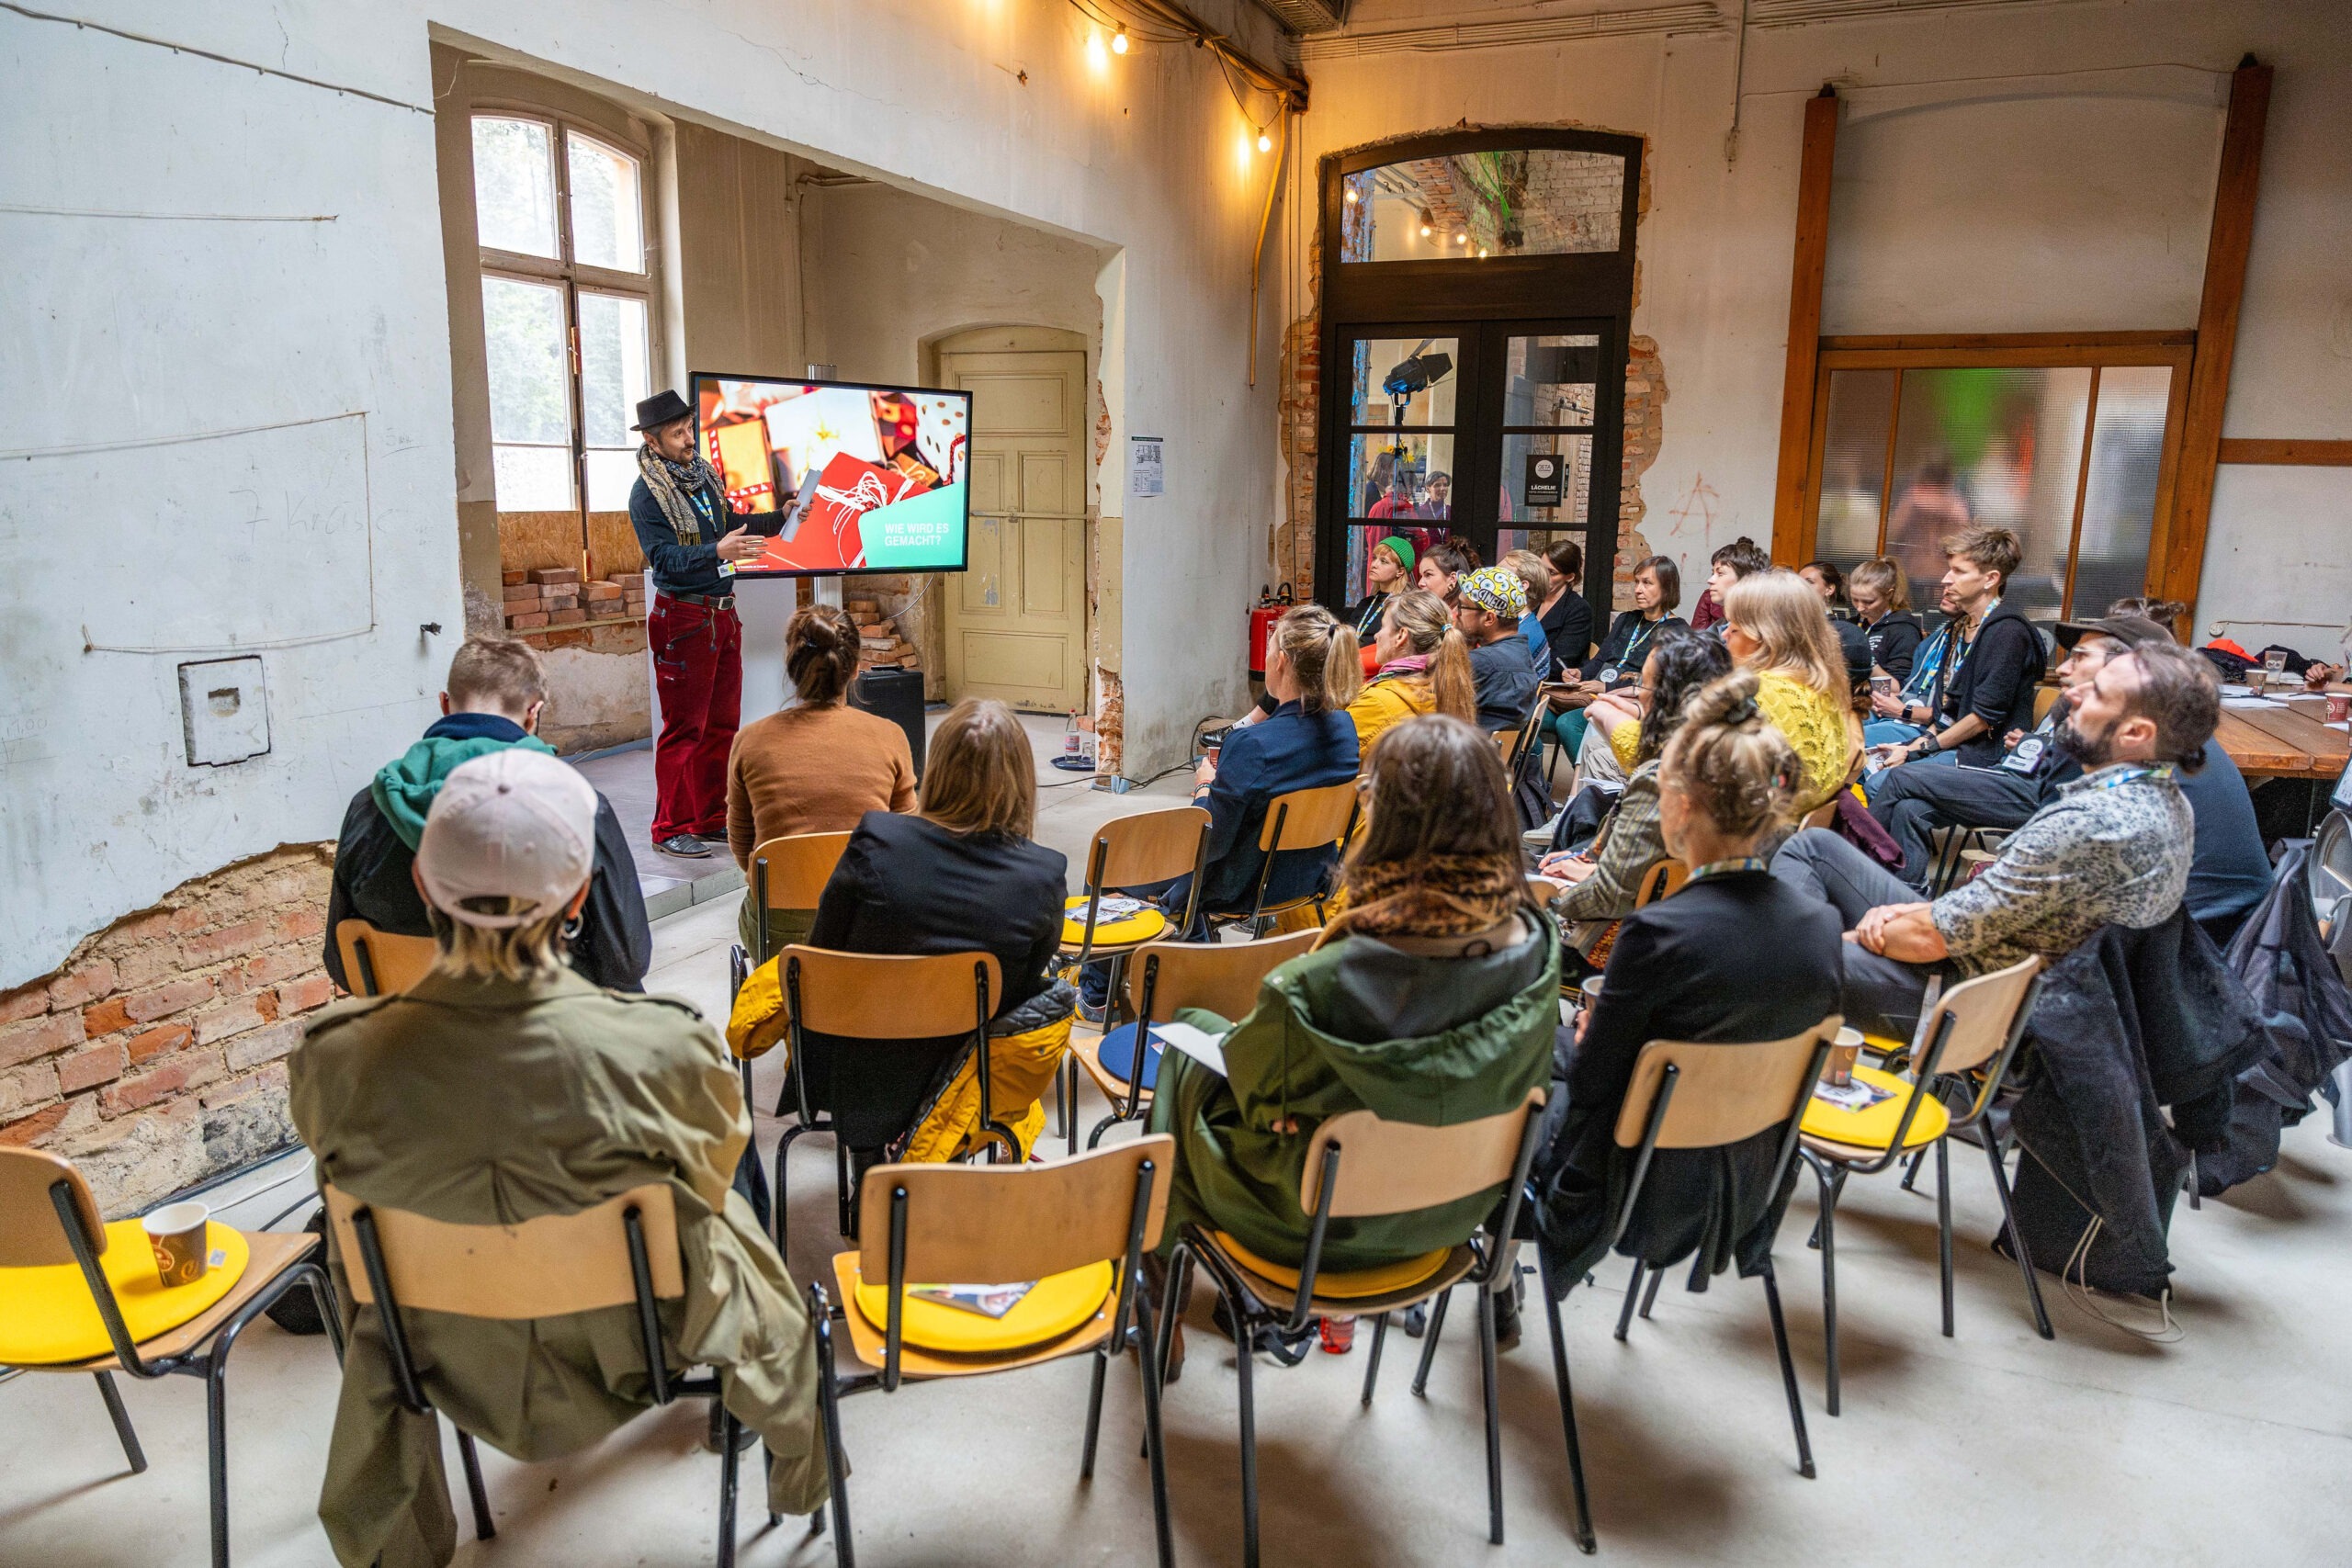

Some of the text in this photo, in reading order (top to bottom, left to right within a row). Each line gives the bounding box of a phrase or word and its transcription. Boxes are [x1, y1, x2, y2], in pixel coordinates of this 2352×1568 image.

[885, 523, 949, 534] WIE WIRD ES
[885, 535, 942, 546] GEMACHT?
